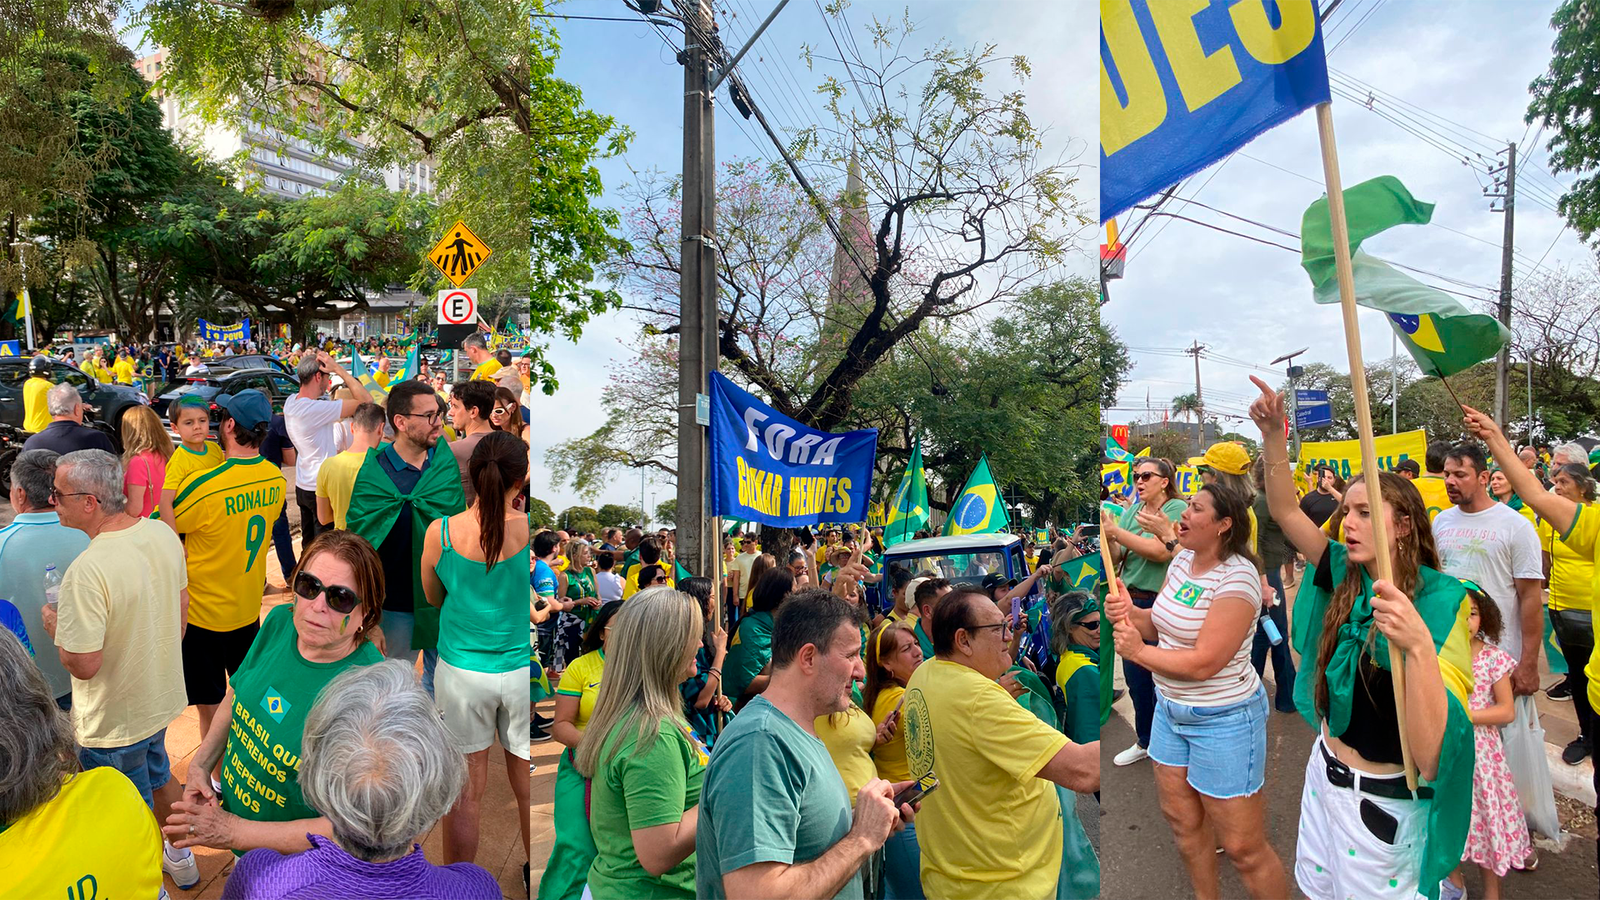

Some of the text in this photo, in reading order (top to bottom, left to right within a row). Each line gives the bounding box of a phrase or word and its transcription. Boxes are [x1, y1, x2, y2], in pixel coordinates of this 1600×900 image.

[453, 299, 464, 317] E
[224, 331, 243, 340] POVO
[744, 406, 846, 466] FORA
[224, 486, 281, 516] RONALDO
[788, 477, 852, 517] MENDES
[244, 514, 267, 574] 9
[235, 701, 271, 749] BRASIL
[223, 765, 261, 814] DE NÓS
[231, 752, 287, 808] DEPENDE
